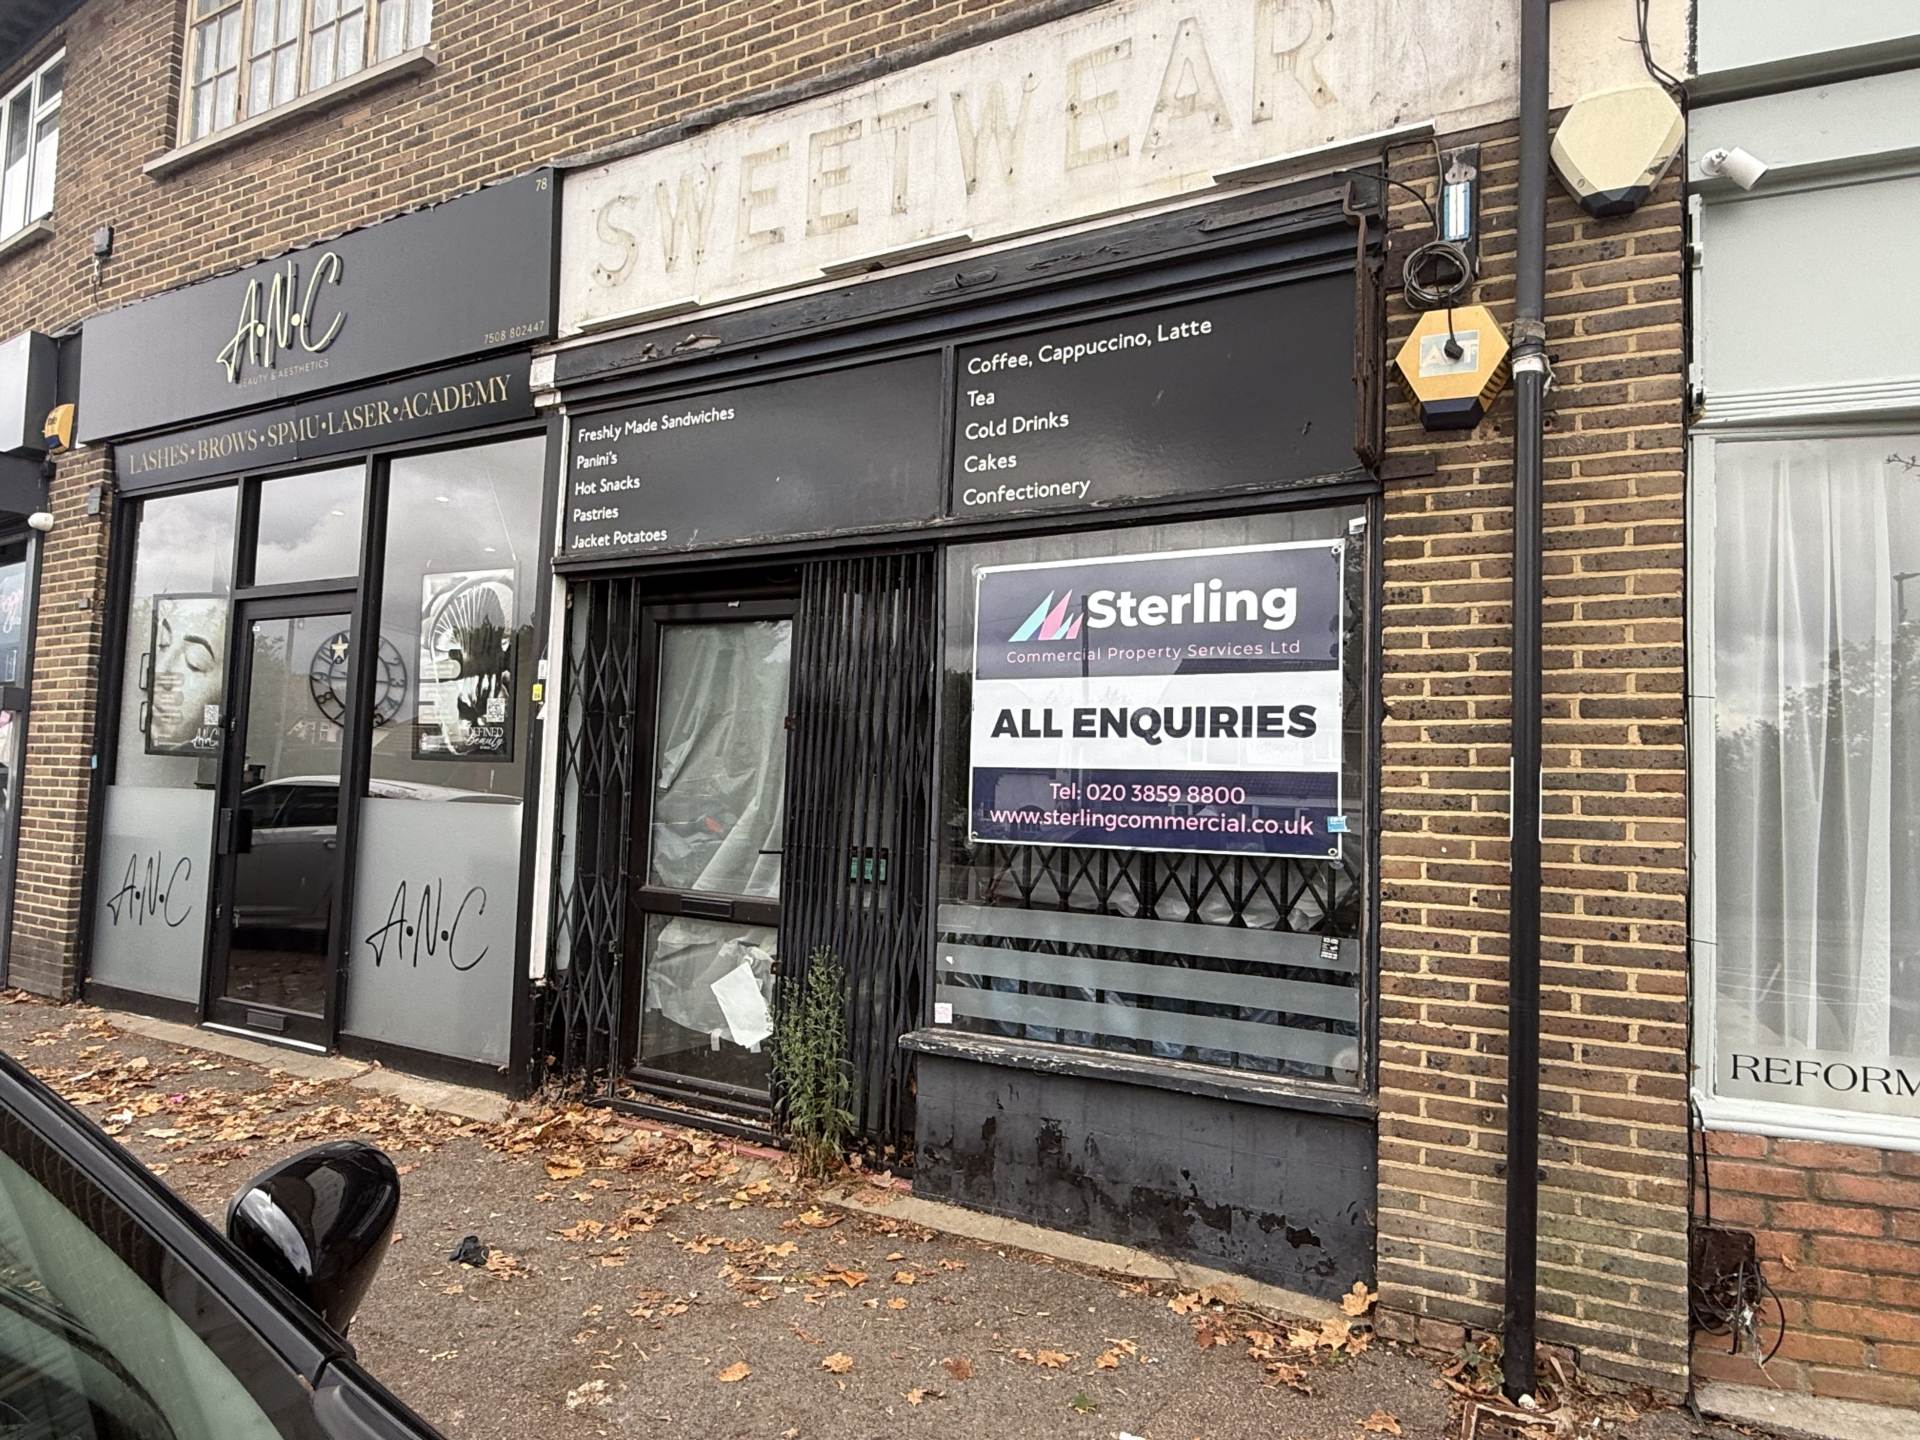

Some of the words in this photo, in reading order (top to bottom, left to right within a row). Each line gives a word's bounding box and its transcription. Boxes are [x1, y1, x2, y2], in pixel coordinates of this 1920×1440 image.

[535, 177, 548, 192] 78
[509, 320, 545, 339] 802447
[967, 351, 1033, 375] Coffee,
[1038, 331, 1152, 365] Cappuccino,
[1157, 319, 1212, 342] Latte
[278, 358, 329, 378] AESTHETICS
[967, 389, 995, 408] Tea
[129, 443, 189, 475] LASHES
[198, 428, 257, 461] BROWS
[267, 414, 319, 448] SPMU
[327, 400, 392, 436] LASER
[399, 374, 511, 421] ACADEMY
[578, 423, 622, 443] Freshly
[624, 418, 658, 436] Made
[661, 406, 735, 430] Sandwiches
[965, 418, 1007, 440] Cold
[1012, 411, 1069, 434] Drinks
[576, 451, 618, 470] Panini's
[964, 453, 1017, 473] Cakes
[574, 481, 597, 496] Hot
[599, 475, 641, 493] Snacks
[963, 479, 1091, 506] Confectionery
[573, 506, 619, 523] Pastries
[571, 531, 610, 549] Jacket
[613, 529, 668, 545] Potatoes
[1086, 578, 1298, 631] Sterling
[1006, 646, 1101, 664] Commercial
[1108, 645, 1181, 662] Property
[1187, 641, 1263, 658] Services
[1270, 639, 1300, 655] Ltd
[990, 707, 1063, 739] ALL
[1072, 704, 1317, 746] ENQUIRIES
[1049, 782, 1082, 801] Tel:
[1086, 783, 1126, 802] 020
[1131, 784, 1181, 803] 3859
[1187, 785, 1246, 805] 8800
[990, 807, 1314, 837] www.sterlingcommercial.co.uk
